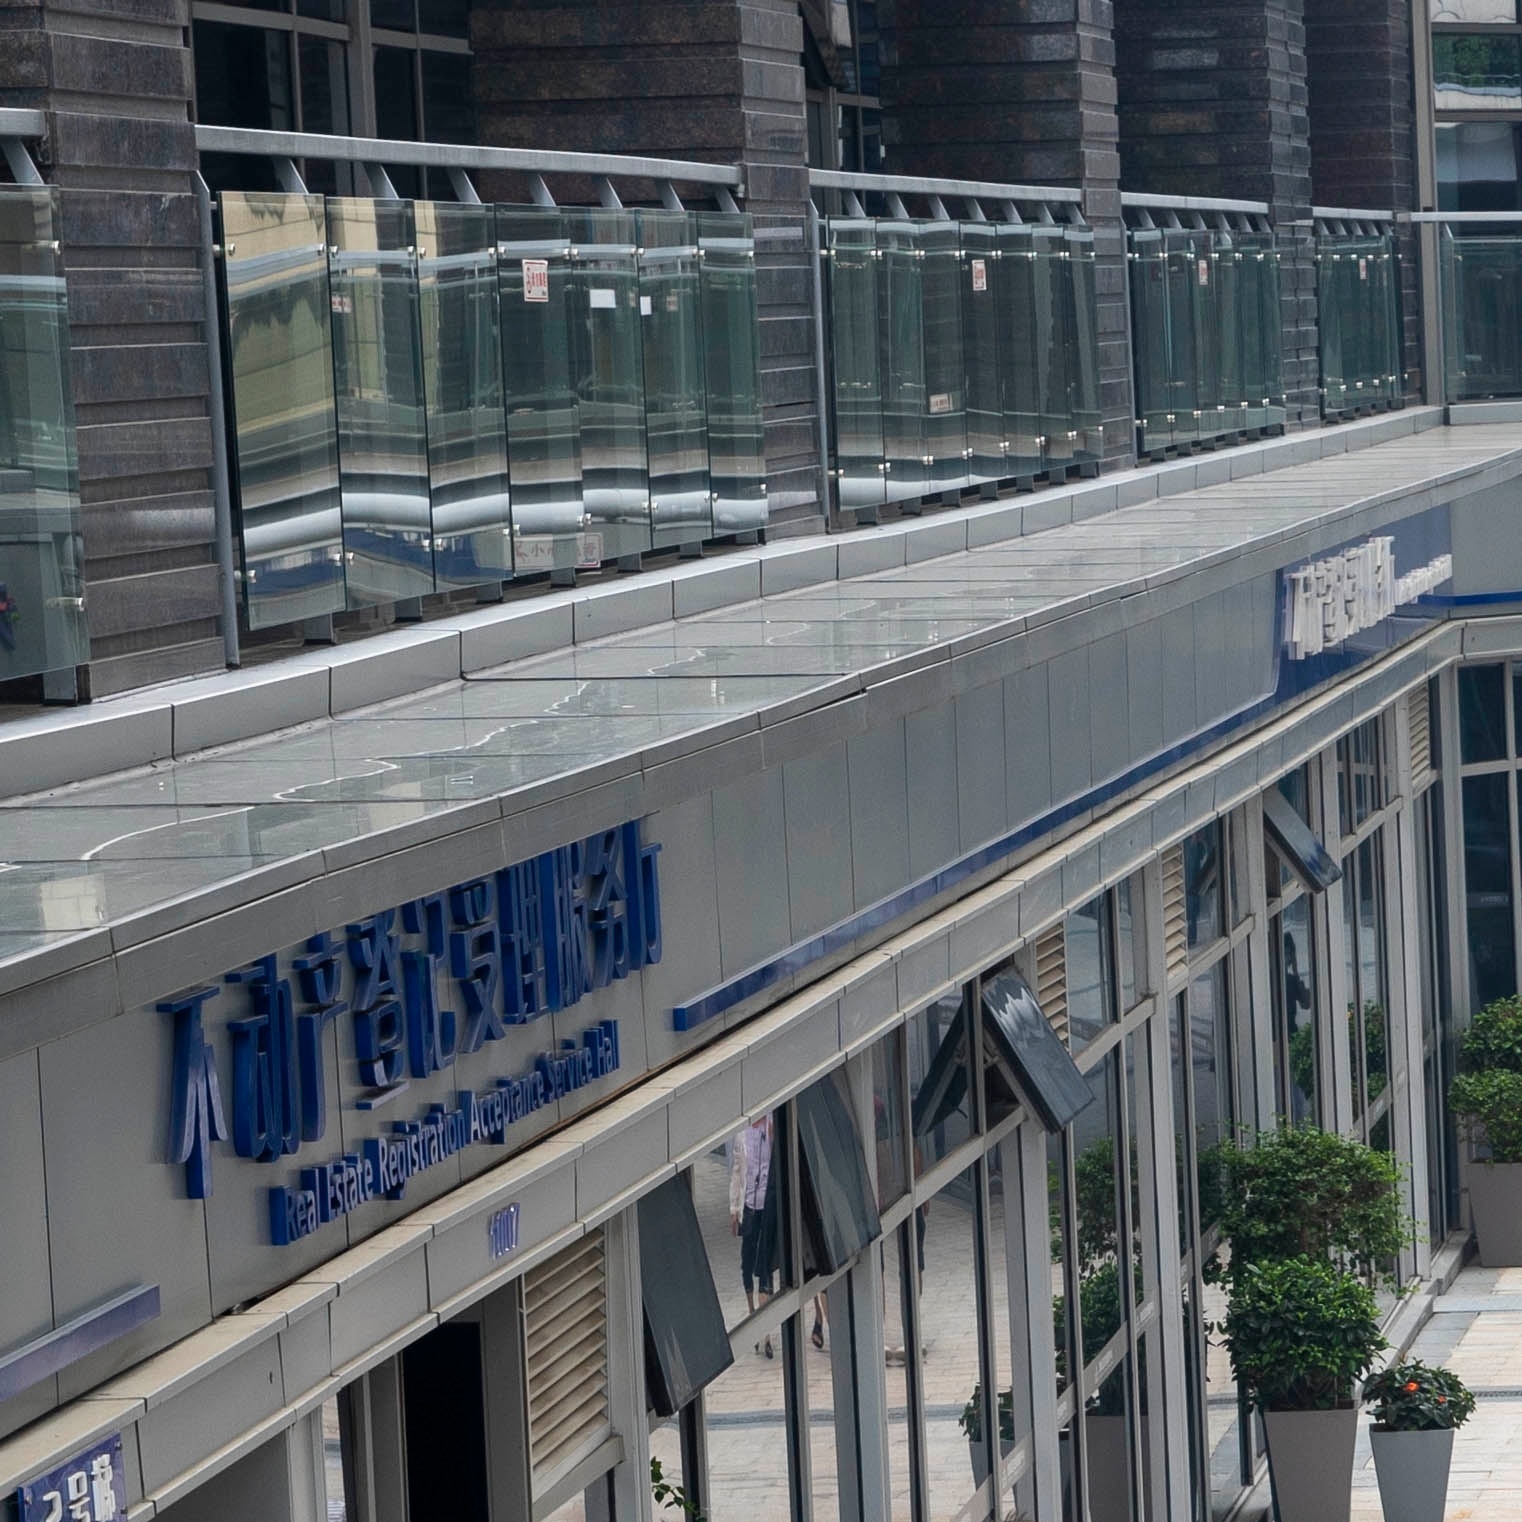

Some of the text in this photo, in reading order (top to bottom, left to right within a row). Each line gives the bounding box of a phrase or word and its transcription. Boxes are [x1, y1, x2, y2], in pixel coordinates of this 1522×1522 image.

[271, 1019, 620, 1245] Real Estate Registration Acceptance Service Hall
